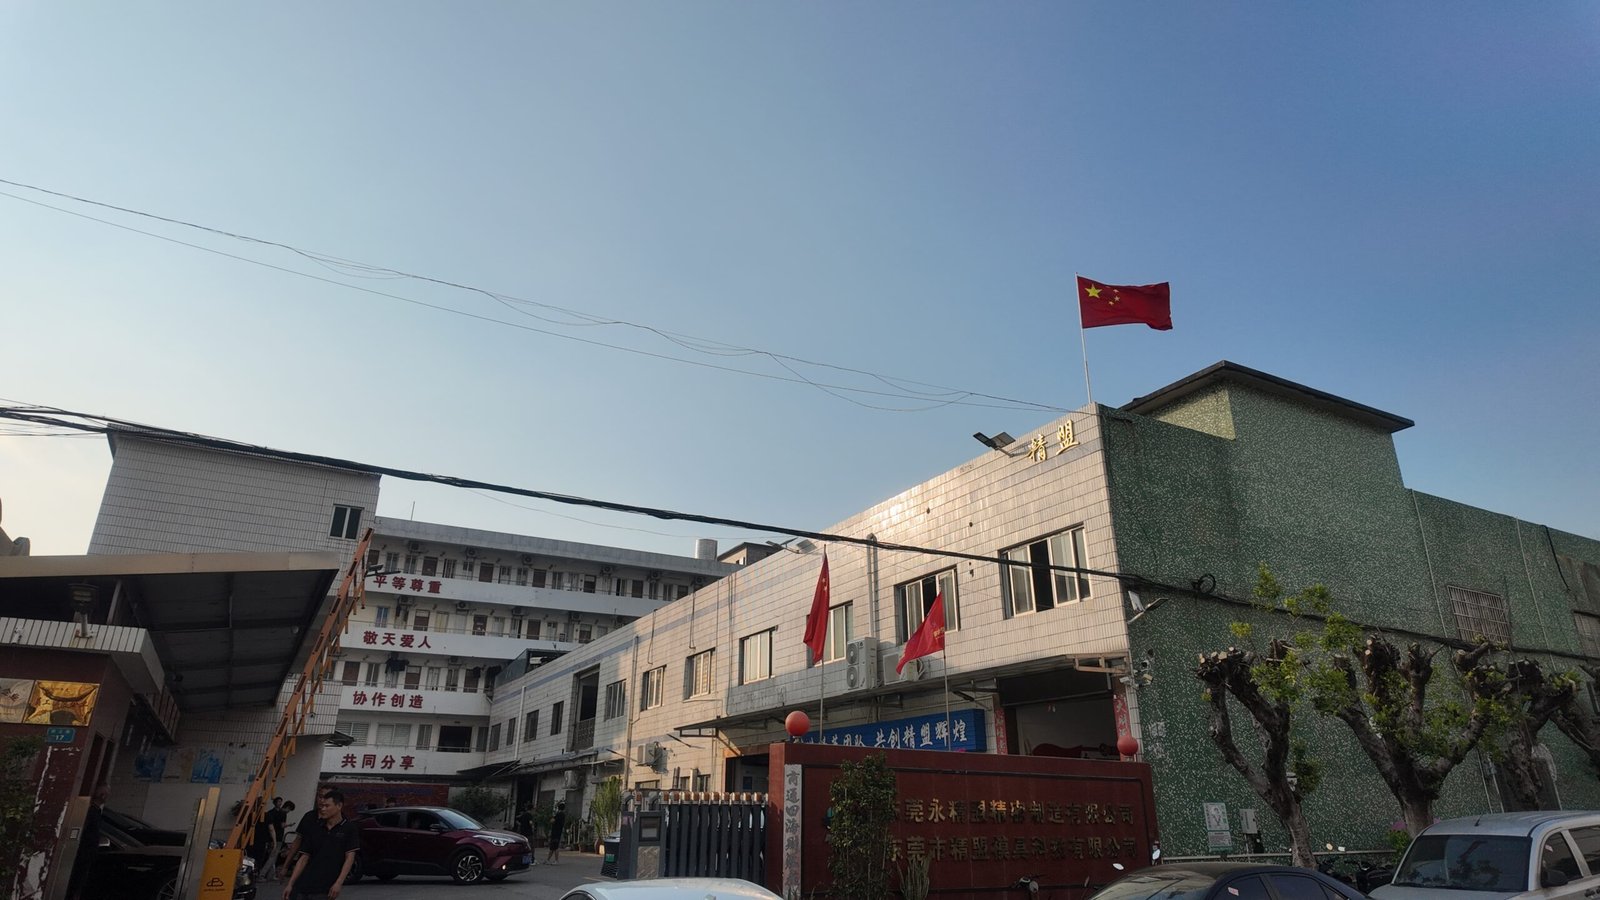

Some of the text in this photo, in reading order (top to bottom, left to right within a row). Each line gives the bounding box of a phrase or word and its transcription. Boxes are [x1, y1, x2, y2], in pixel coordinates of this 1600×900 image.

[1027, 419, 1080, 462] 精盟
[373, 575, 442, 594] 平等尊重
[363, 630, 431, 649] 敬天爱人
[352, 691, 424, 709] 协作创造
[874, 719, 968, 749] 共创精盟辉煌
[341, 753, 416, 770] 共同分享
